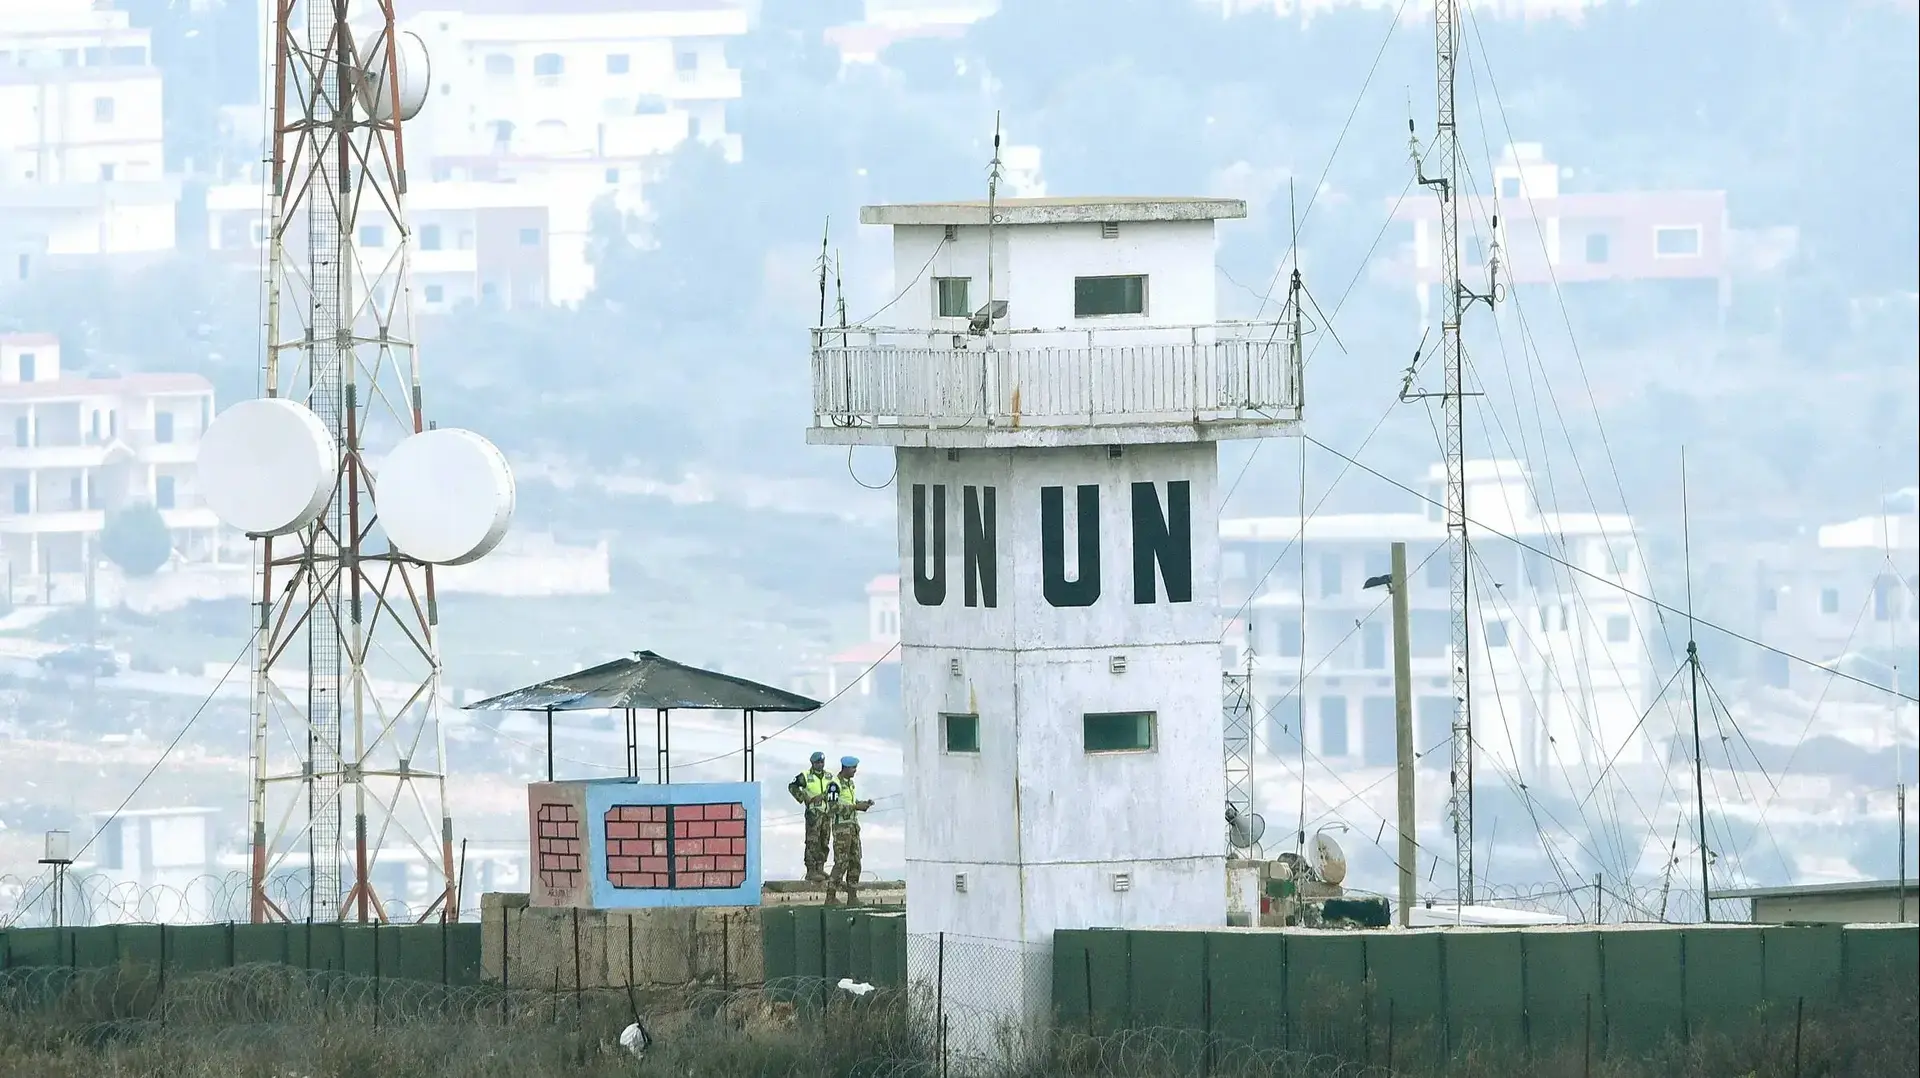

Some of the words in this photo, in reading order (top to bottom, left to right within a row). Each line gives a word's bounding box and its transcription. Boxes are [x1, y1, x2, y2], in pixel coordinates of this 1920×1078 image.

[912, 484, 997, 608] UN
[1040, 480, 1192, 607] UN
[827, 791, 839, 801] MP
